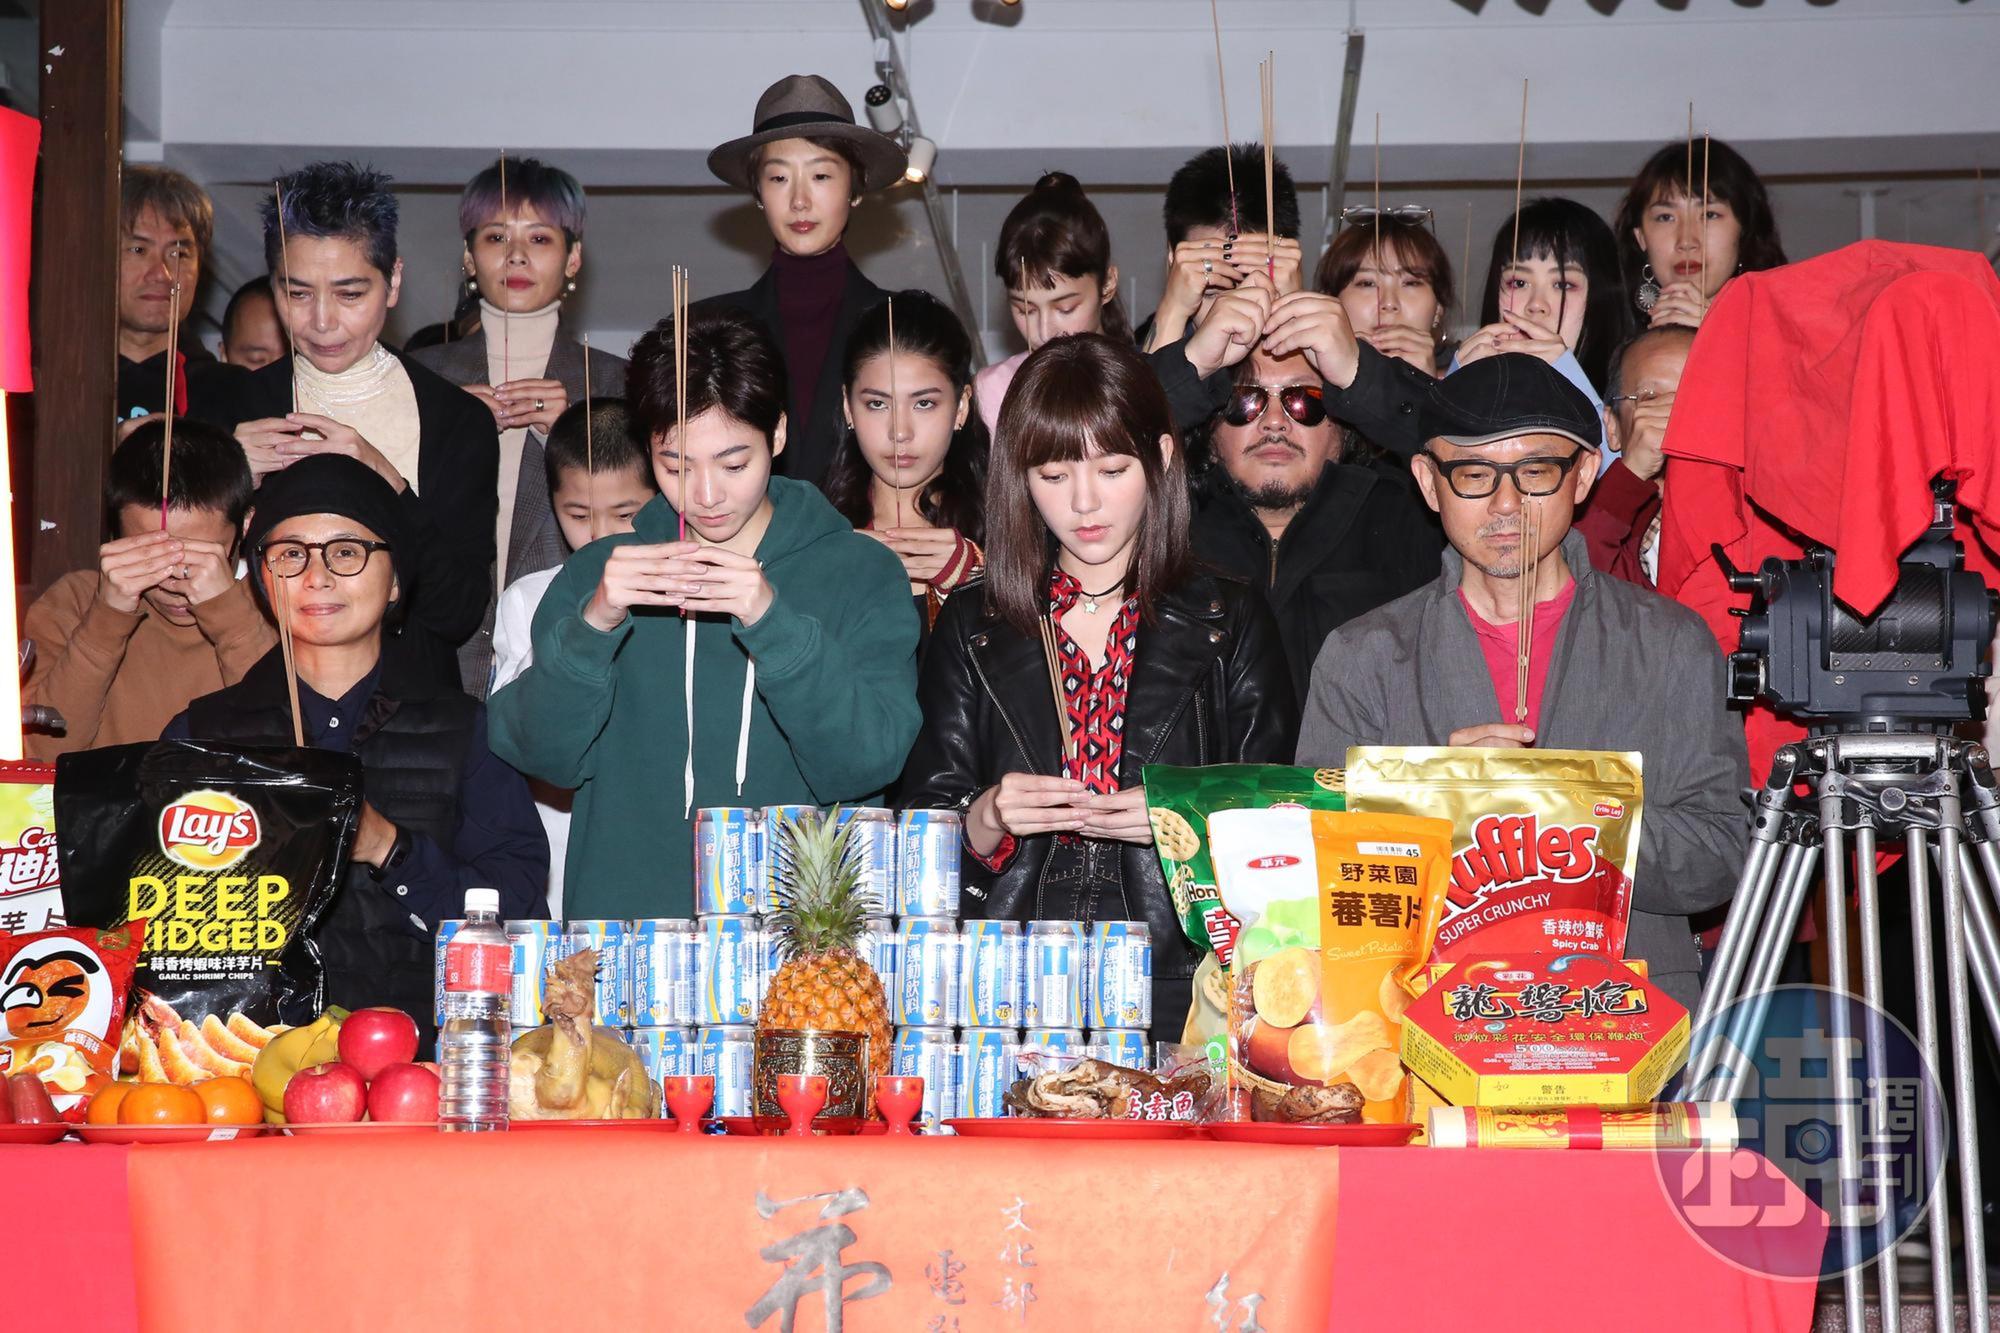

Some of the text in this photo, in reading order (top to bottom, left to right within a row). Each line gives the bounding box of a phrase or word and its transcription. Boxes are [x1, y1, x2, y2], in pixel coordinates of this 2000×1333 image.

[168, 806, 252, 856] Lay's
[1260, 857, 1288, 868] 華元
[1341, 862, 1418, 886] 野菜園
[128, 874, 290, 922] DEEP
[1439, 892, 1551, 946] SUPER CRUNCHY
[1542, 918, 1605, 940] 香辣炒蟹味
[142, 919, 287, 952] IDGED
[1552, 938, 1599, 950] Spicy Crab
[1326, 945, 1366, 961] Sweet
[158, 972, 254, 980] GARLIC SHRIMP CHIPS
